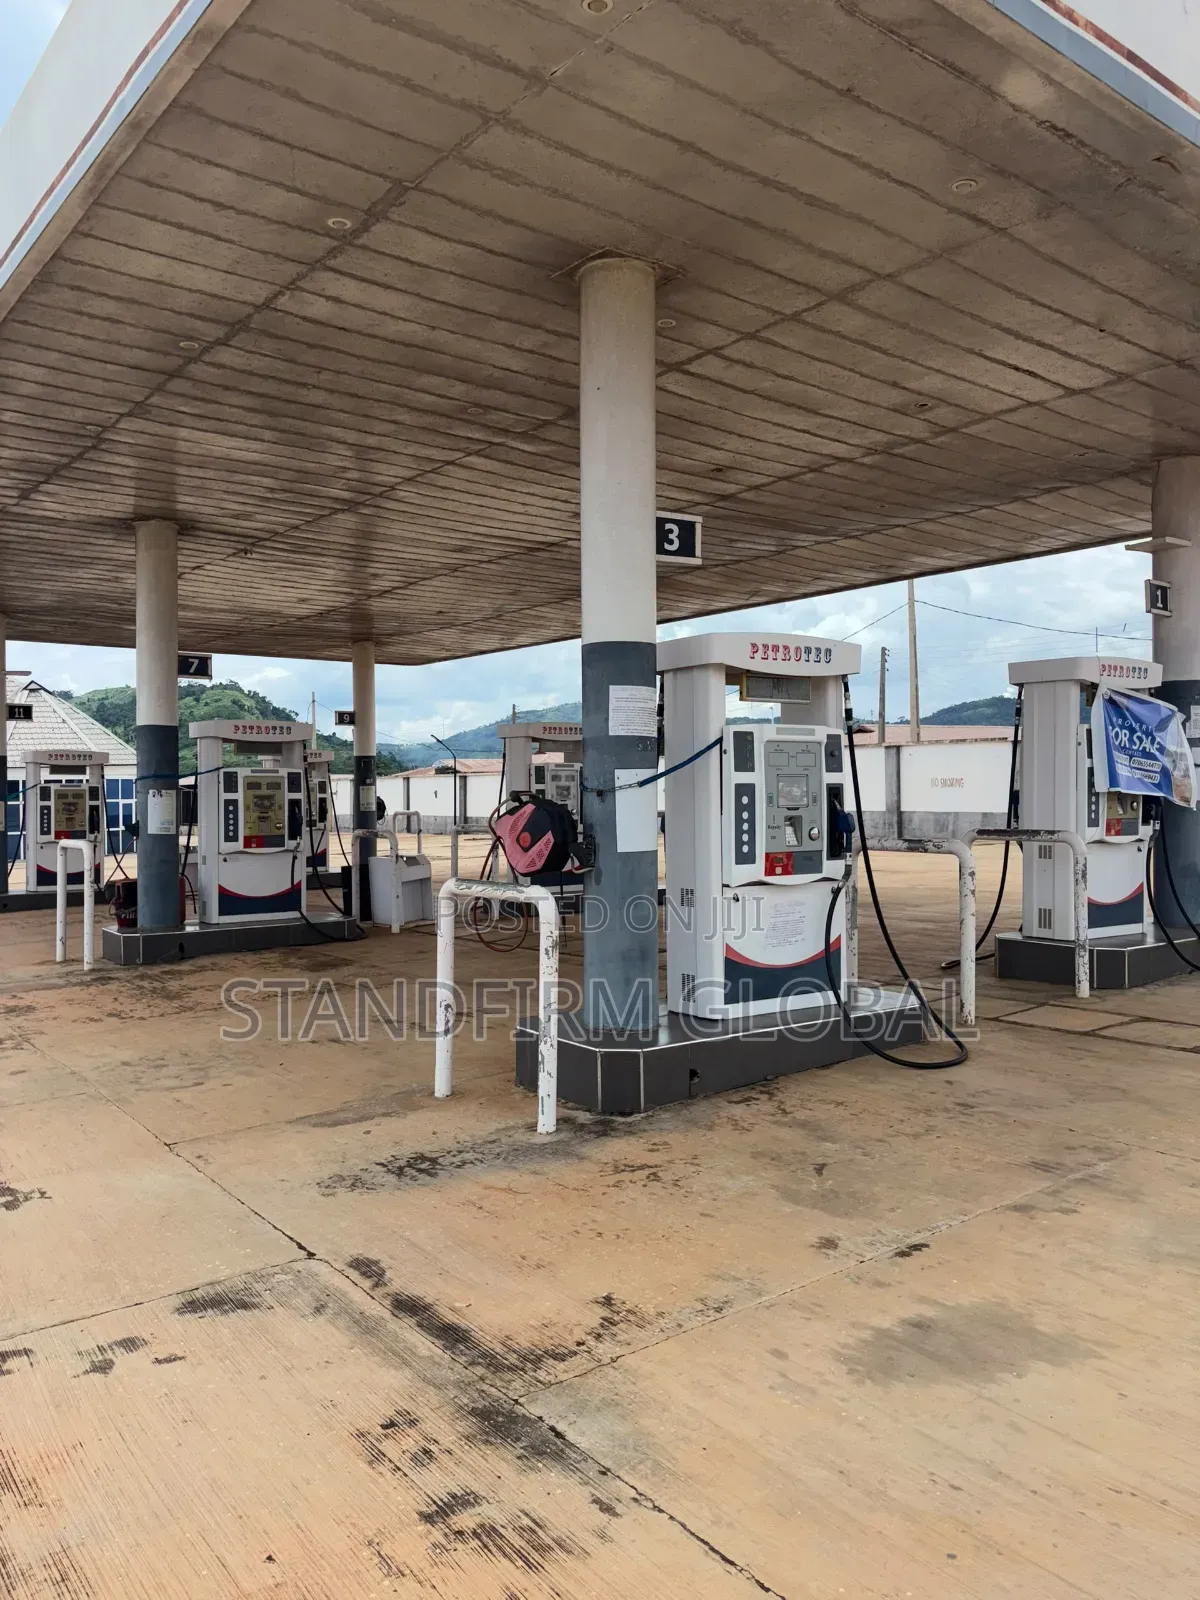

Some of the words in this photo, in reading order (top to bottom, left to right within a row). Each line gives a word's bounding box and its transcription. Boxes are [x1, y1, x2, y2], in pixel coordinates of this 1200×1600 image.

[663, 523, 680, 551] 3
[1156, 589, 1163, 608] 1
[749, 642, 832, 664] PETROTEC
[188, 658, 200, 674] 7
[1100, 663, 1149, 680] PETROTEC
[14, 707, 25, 718] 11
[343, 713, 350, 723] 9
[233, 724, 292, 735] PETROTEC
[1132, 732, 1160, 753] SALE
